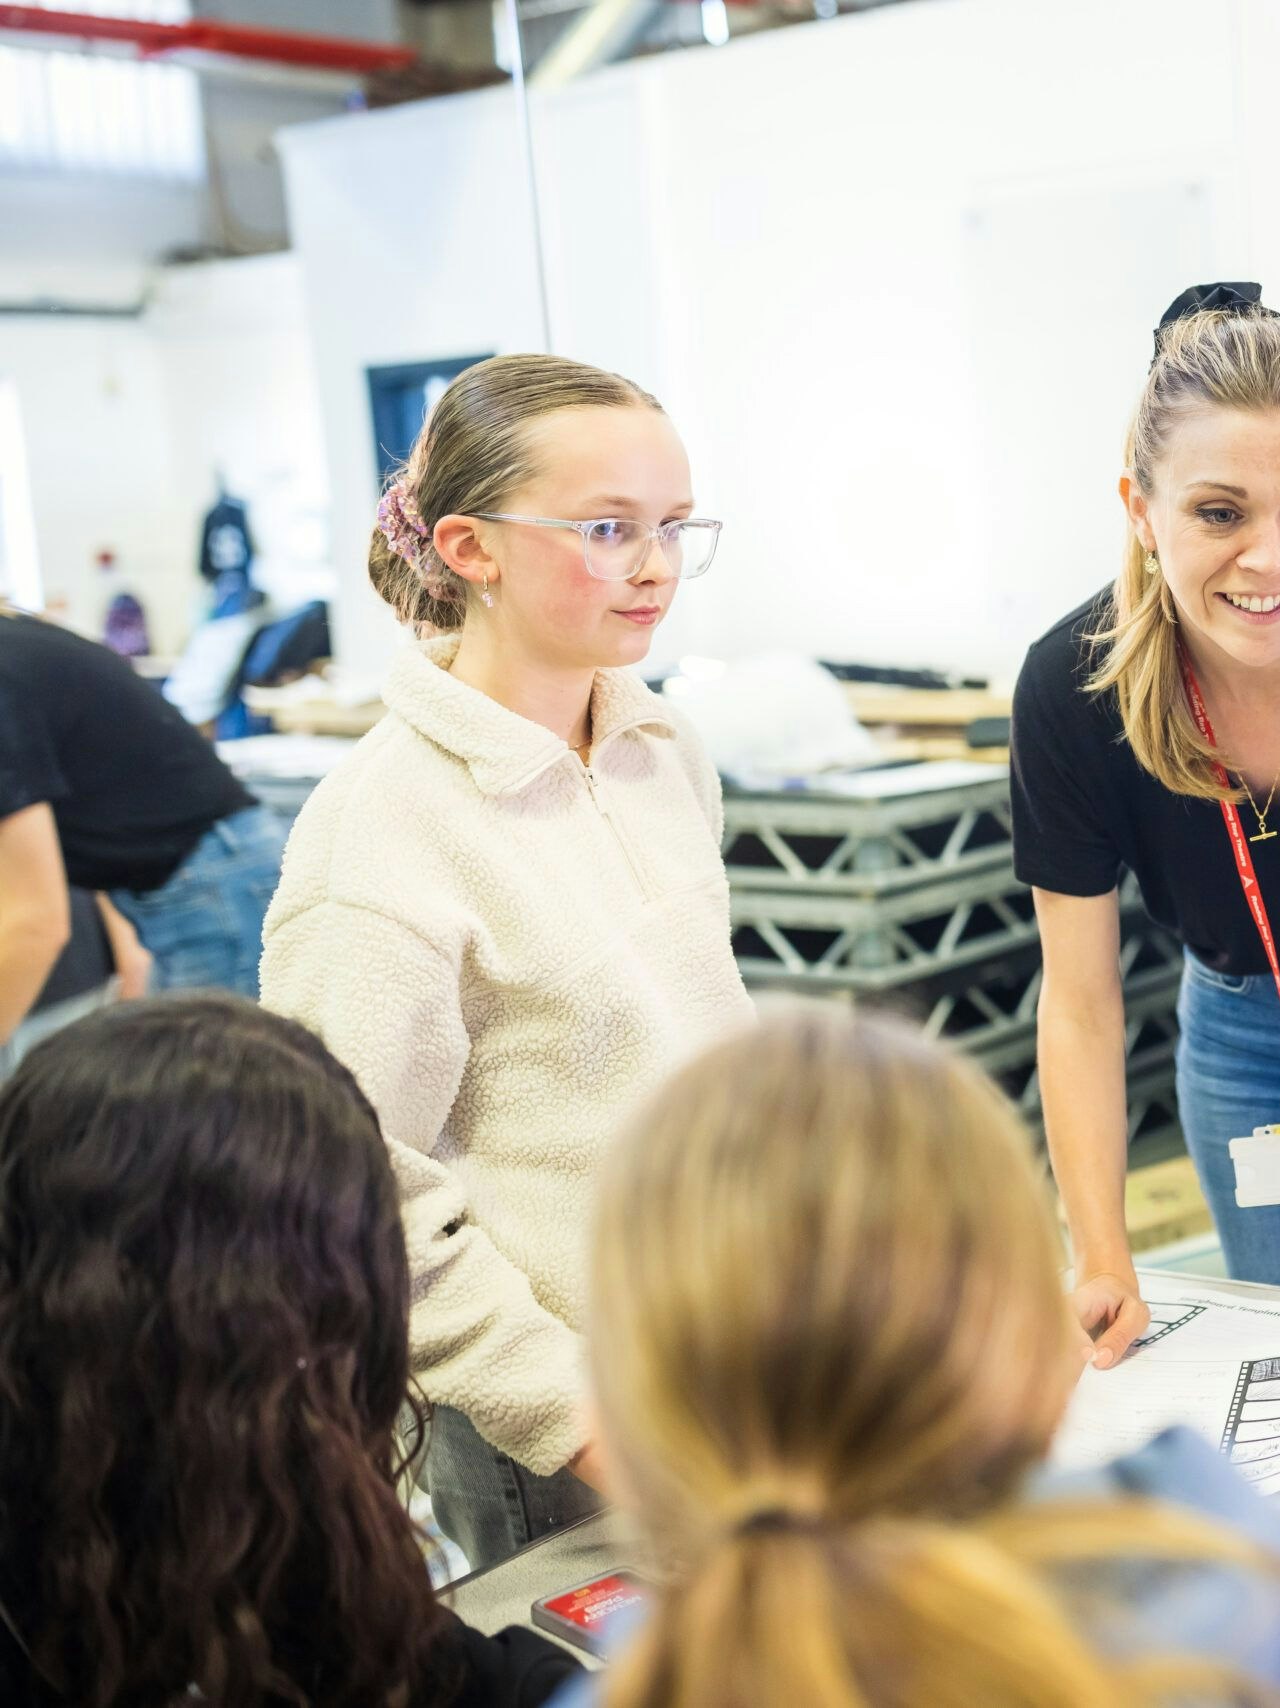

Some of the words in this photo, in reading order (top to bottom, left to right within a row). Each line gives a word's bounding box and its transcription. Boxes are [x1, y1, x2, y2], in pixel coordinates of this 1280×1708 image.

[1230, 821, 1239, 838] Rep
[1237, 838, 1246, 867] Theatre
[1251, 895, 1264, 925] Reading
